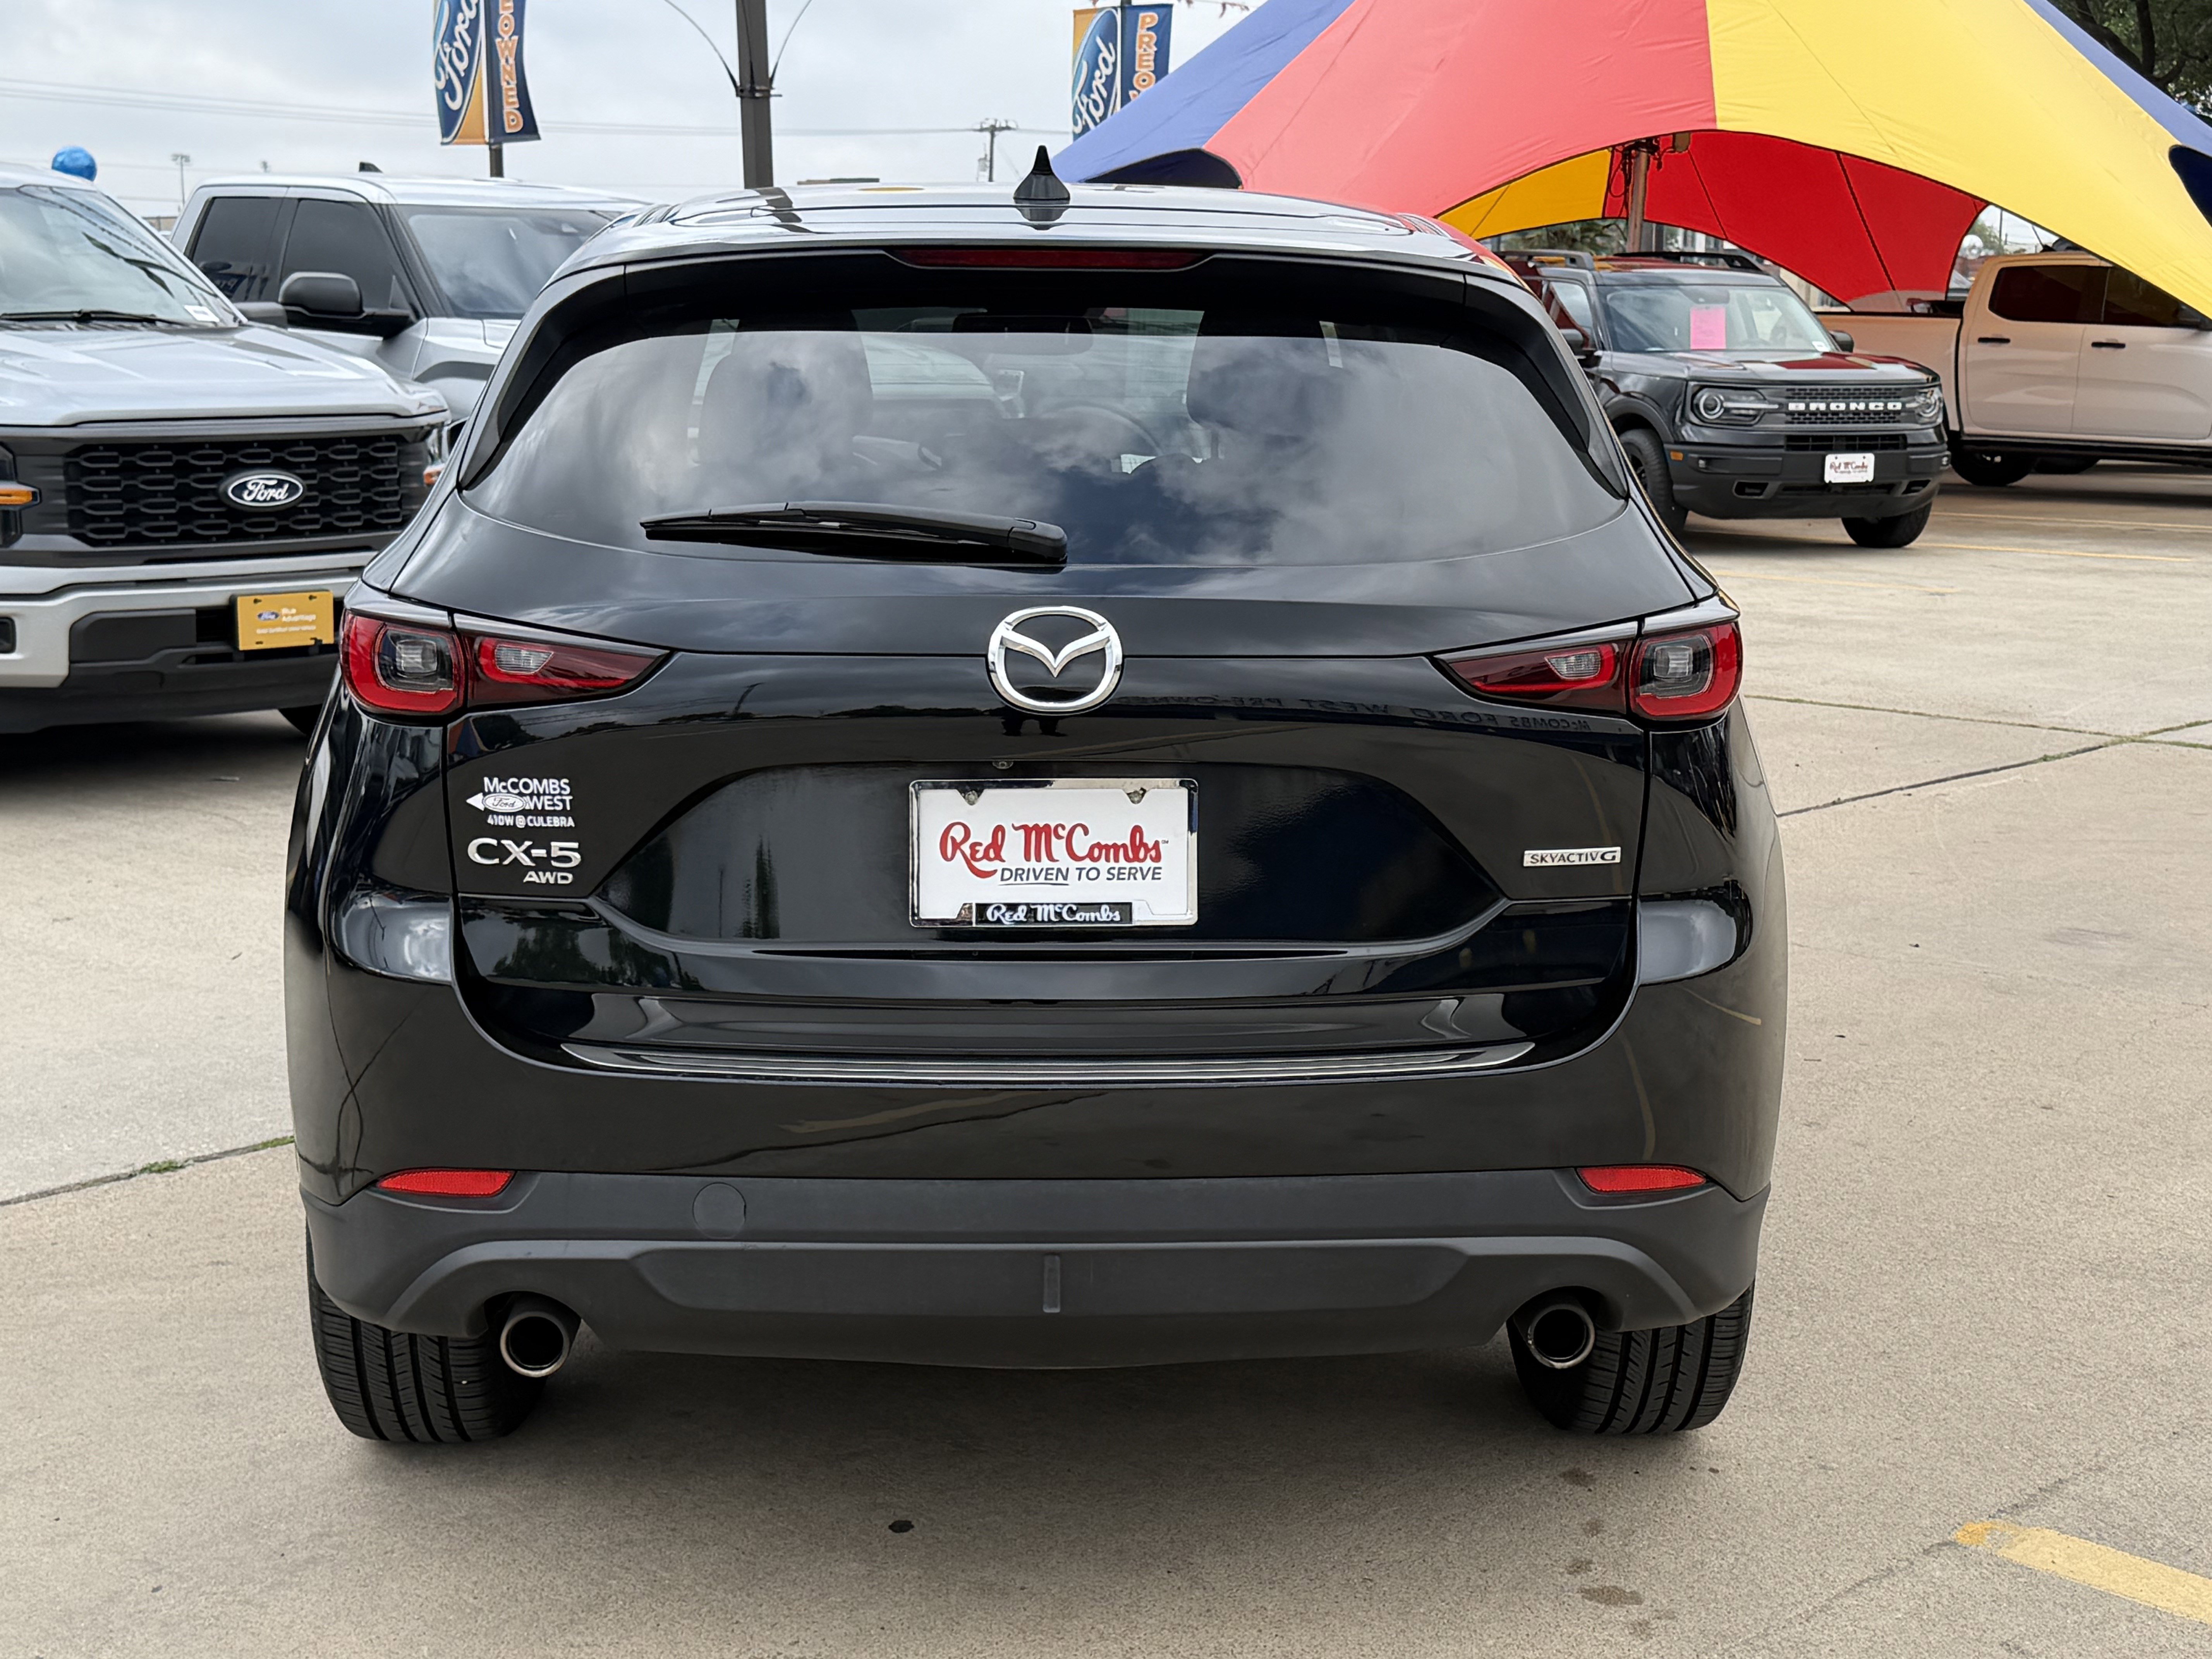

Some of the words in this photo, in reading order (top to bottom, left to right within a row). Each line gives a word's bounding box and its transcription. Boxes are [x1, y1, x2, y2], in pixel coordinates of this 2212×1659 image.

[1788, 402, 1902, 410] BRONCO
[243, 479, 289, 501] Ford
[484, 777, 570, 794] McCOMBS
[527, 795, 573, 811] WEST
[467, 838, 581, 868] CX-5
[939, 821, 1005, 879] Red
[1012, 823, 1162, 863] McCombs
[523, 871, 573, 884] AWD
[1000, 867, 1069, 882] DRIVEN
[1076, 867, 1100, 881] TO
[1106, 867, 1162, 881] SERVE
[986, 904, 1026, 924] Red
[1030, 904, 1120, 922] McCombs
